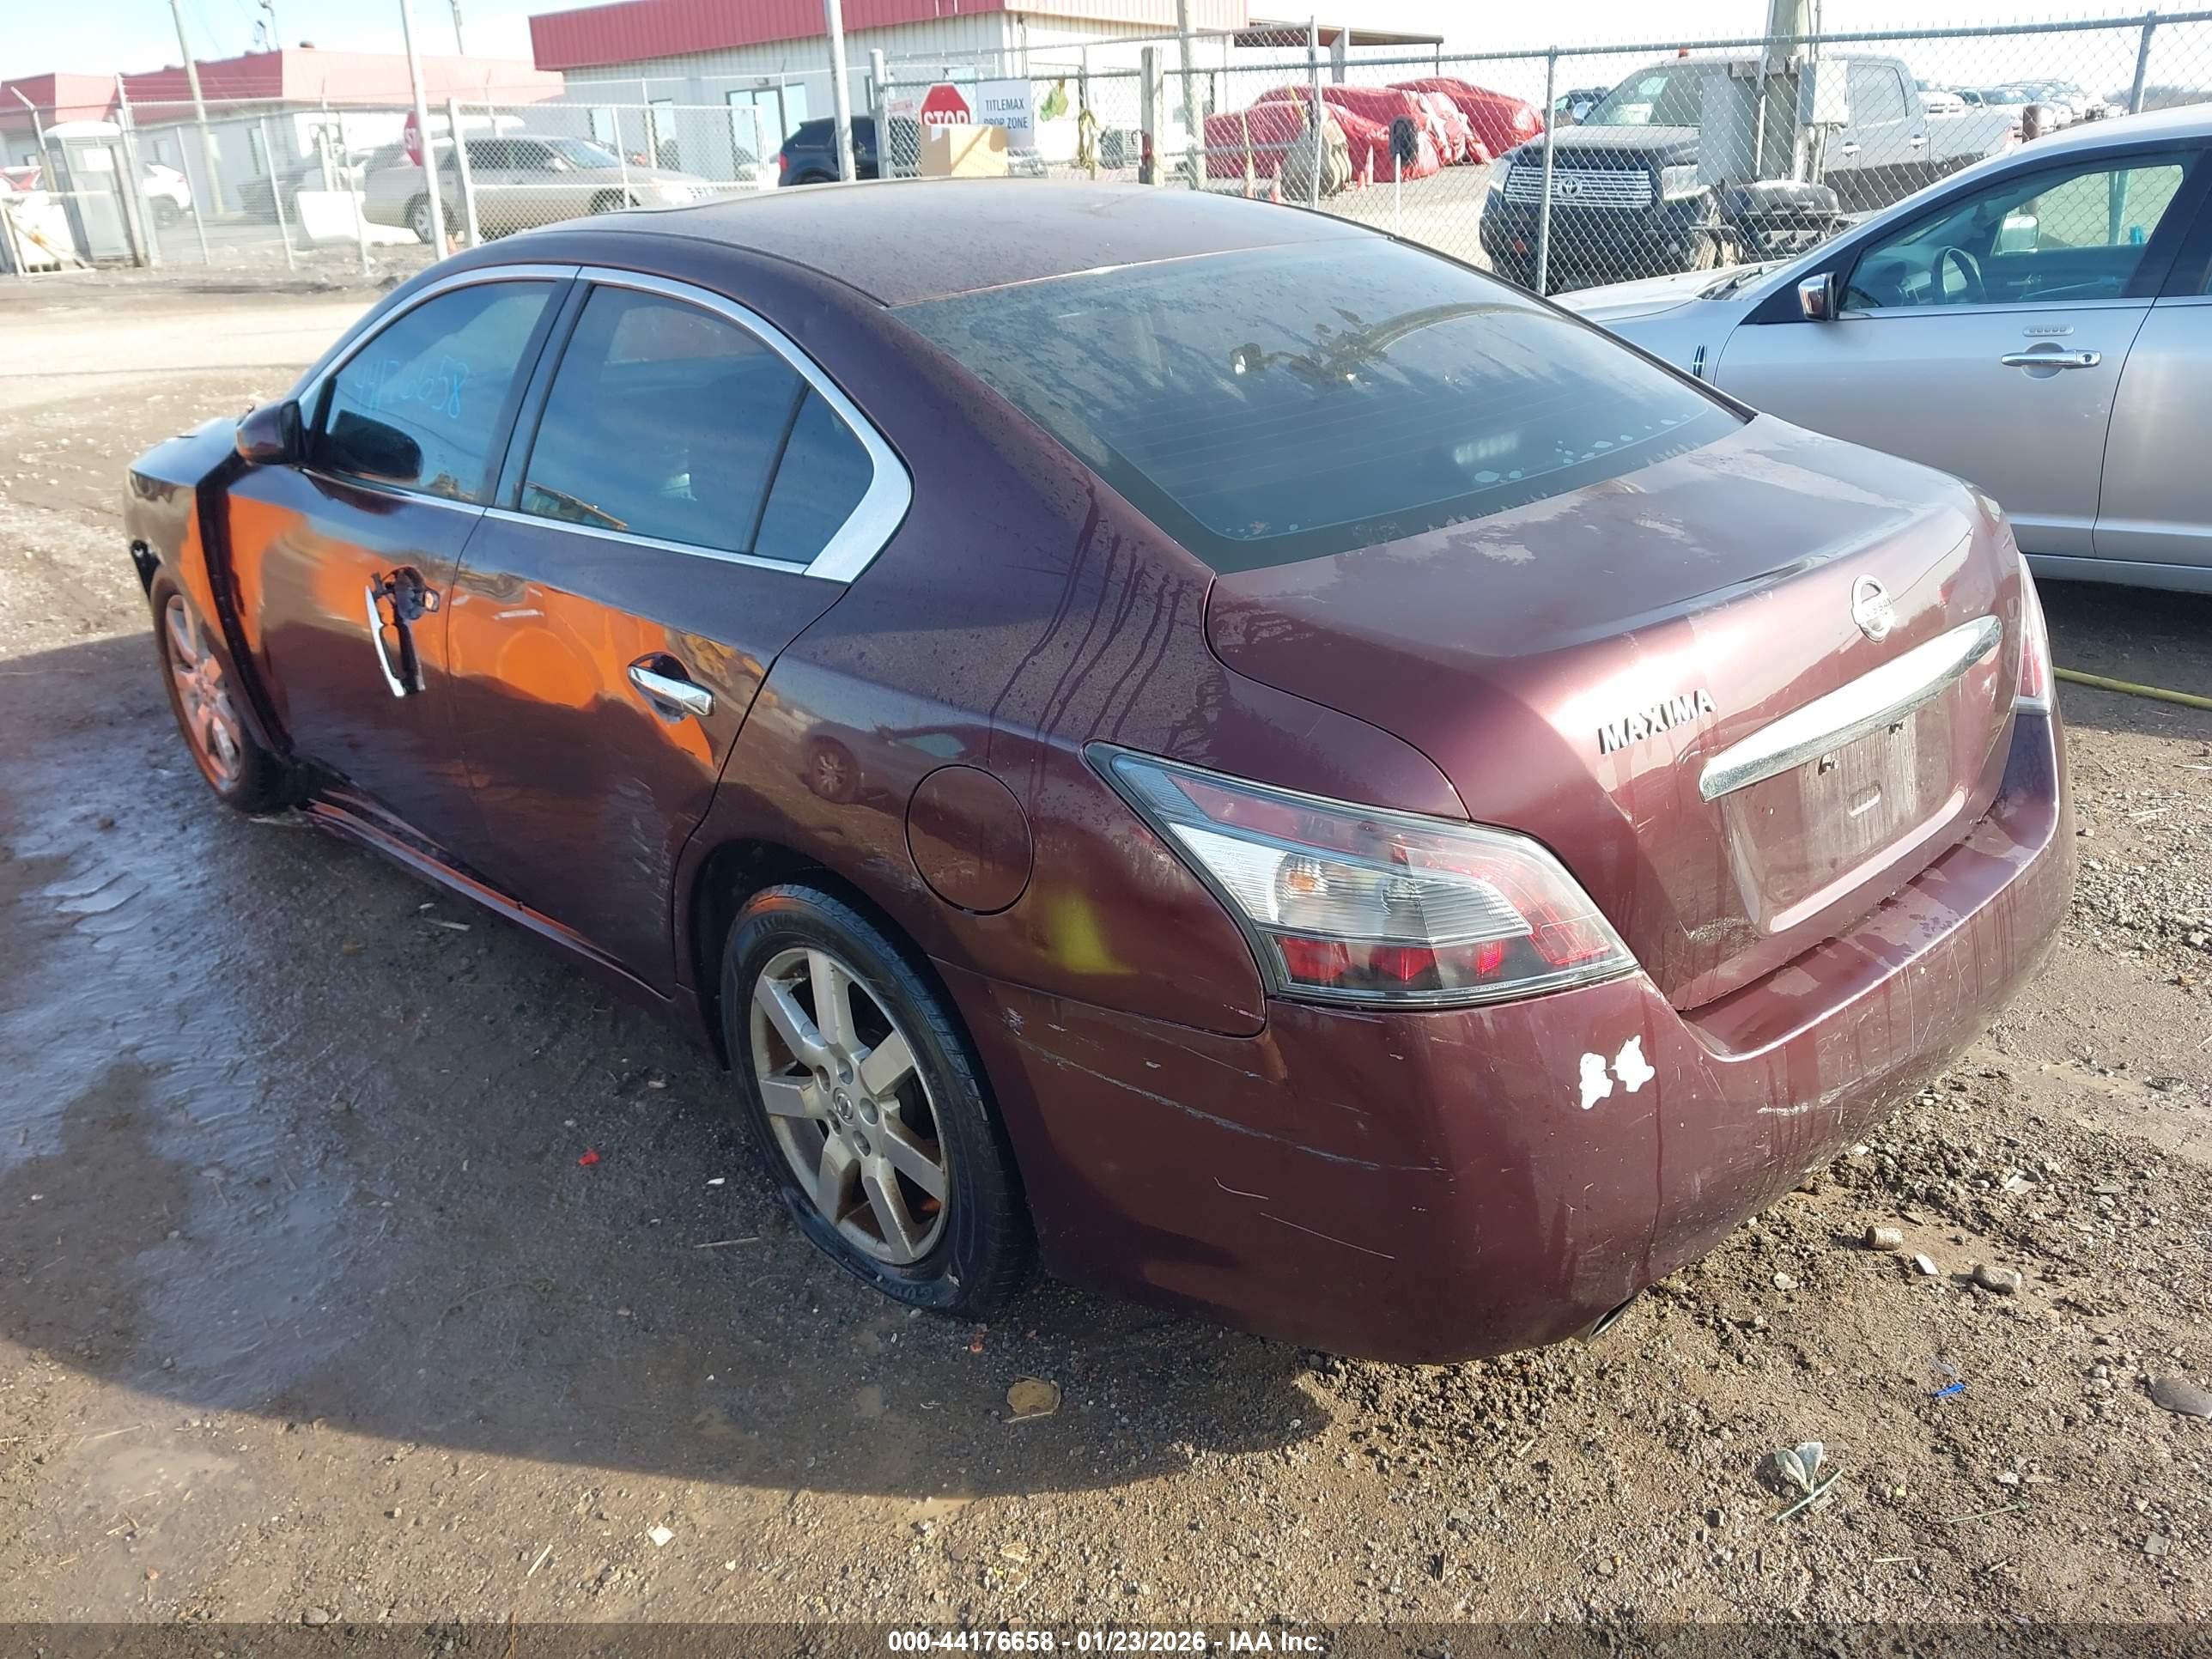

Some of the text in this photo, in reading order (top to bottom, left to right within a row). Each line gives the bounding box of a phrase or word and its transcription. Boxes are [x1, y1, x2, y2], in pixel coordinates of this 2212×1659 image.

[985, 98, 1024, 111] TITLEMAX
[923, 110, 969, 125] STOP
[1006, 117, 1029, 130] ZONE
[1597, 687, 1718, 756] MAXIMA
